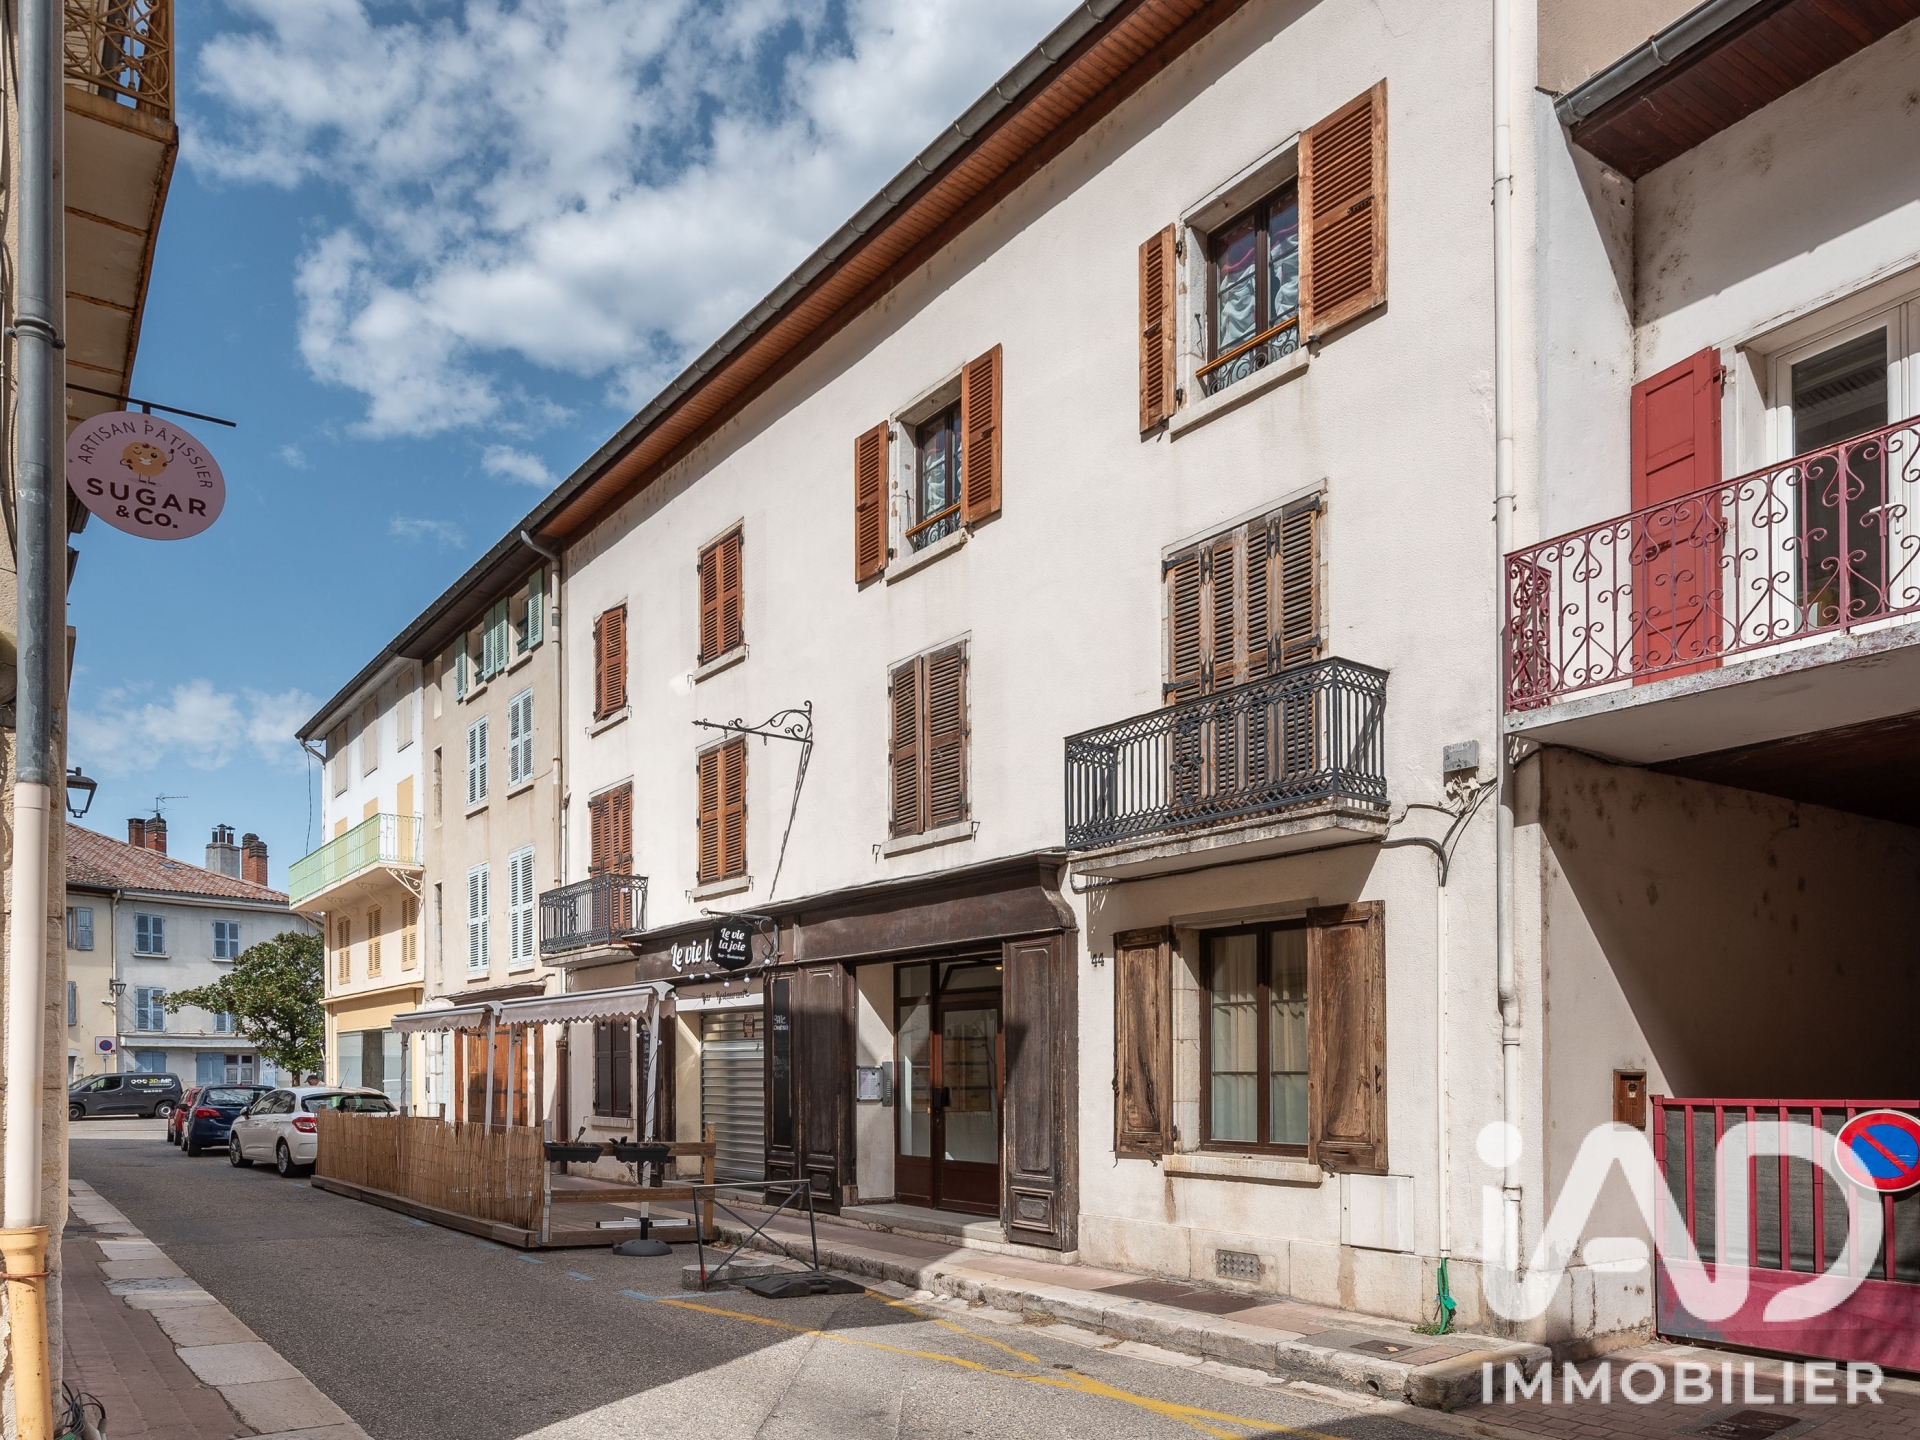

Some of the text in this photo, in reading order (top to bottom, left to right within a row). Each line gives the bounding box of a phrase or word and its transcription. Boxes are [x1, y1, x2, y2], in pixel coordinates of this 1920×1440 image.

[78, 421, 213, 489] ARTISAN PÂTISSIER
[86, 478, 207, 517] SUGAR
[718, 940, 746, 952] la joie
[721, 928, 745, 940] Le vie
[671, 942, 683, 973] Le
[685, 940, 702, 964] vie
[1091, 952, 1105, 967] 44
